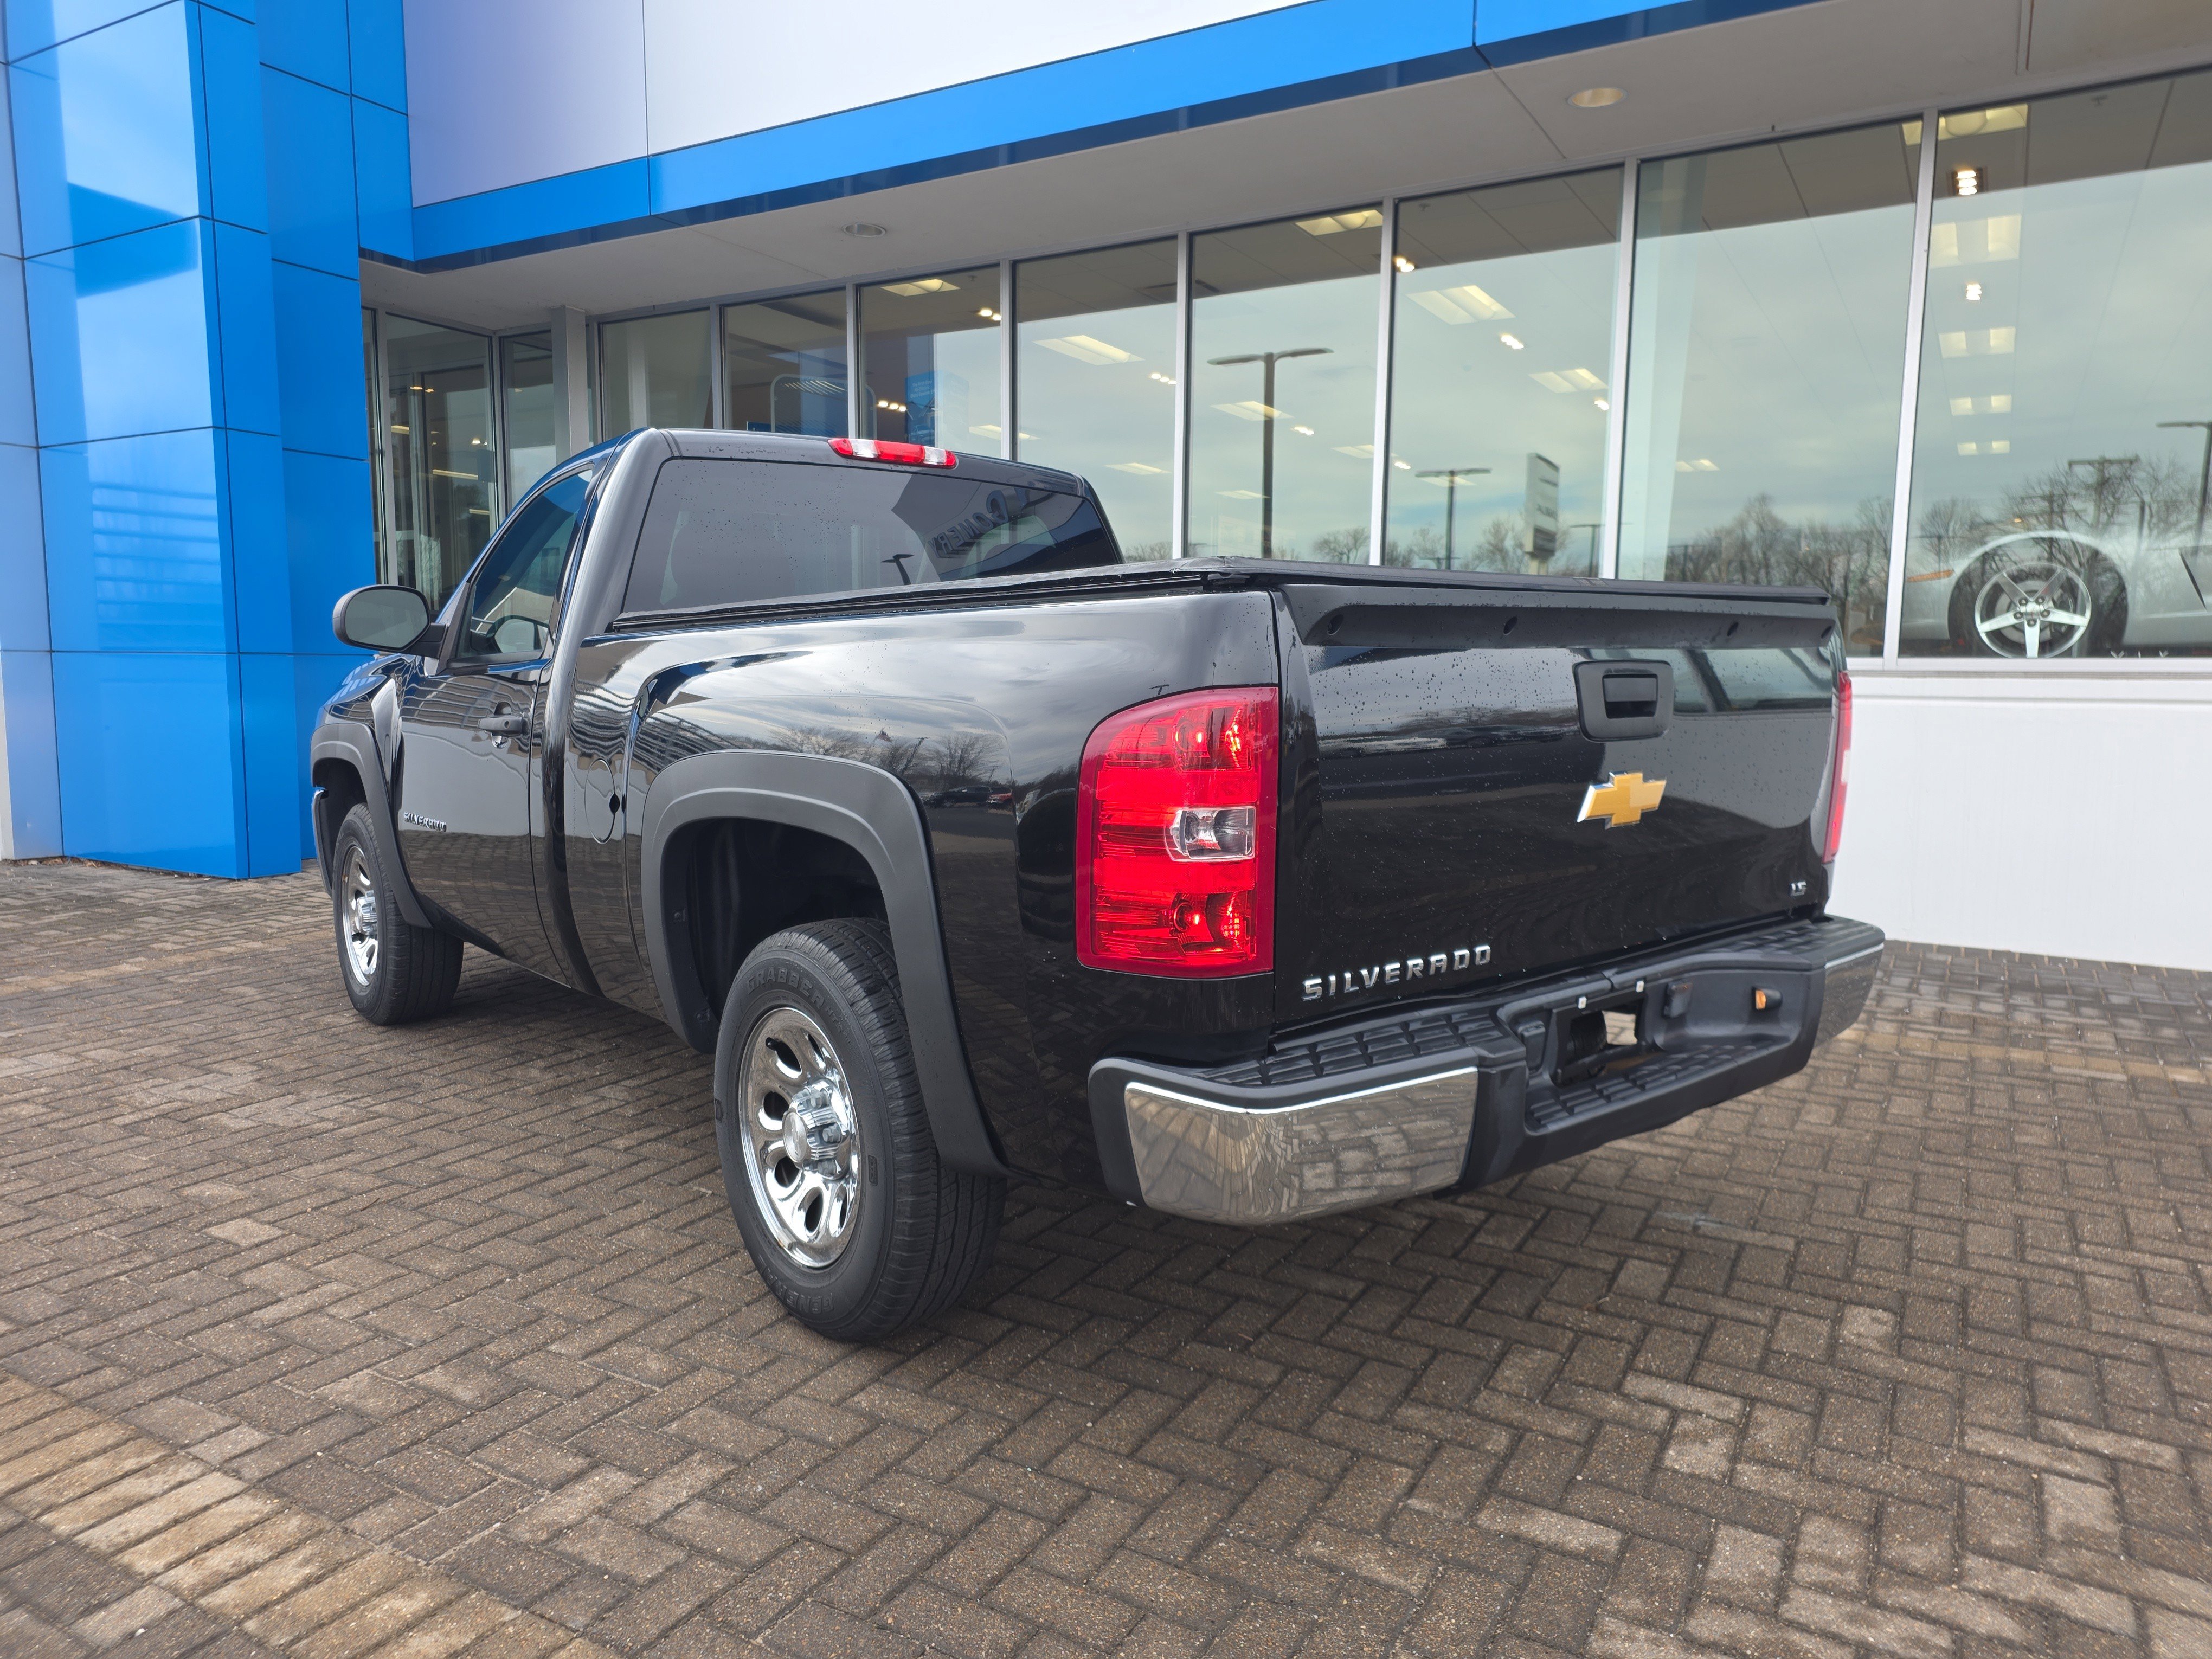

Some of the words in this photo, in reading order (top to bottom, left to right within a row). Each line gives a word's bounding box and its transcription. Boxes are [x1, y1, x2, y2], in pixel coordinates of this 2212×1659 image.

[403, 812, 447, 832] SILVERADO
[747, 967, 825, 1009] GRABBER
[1302, 944, 1491, 1001] SILVERADO
